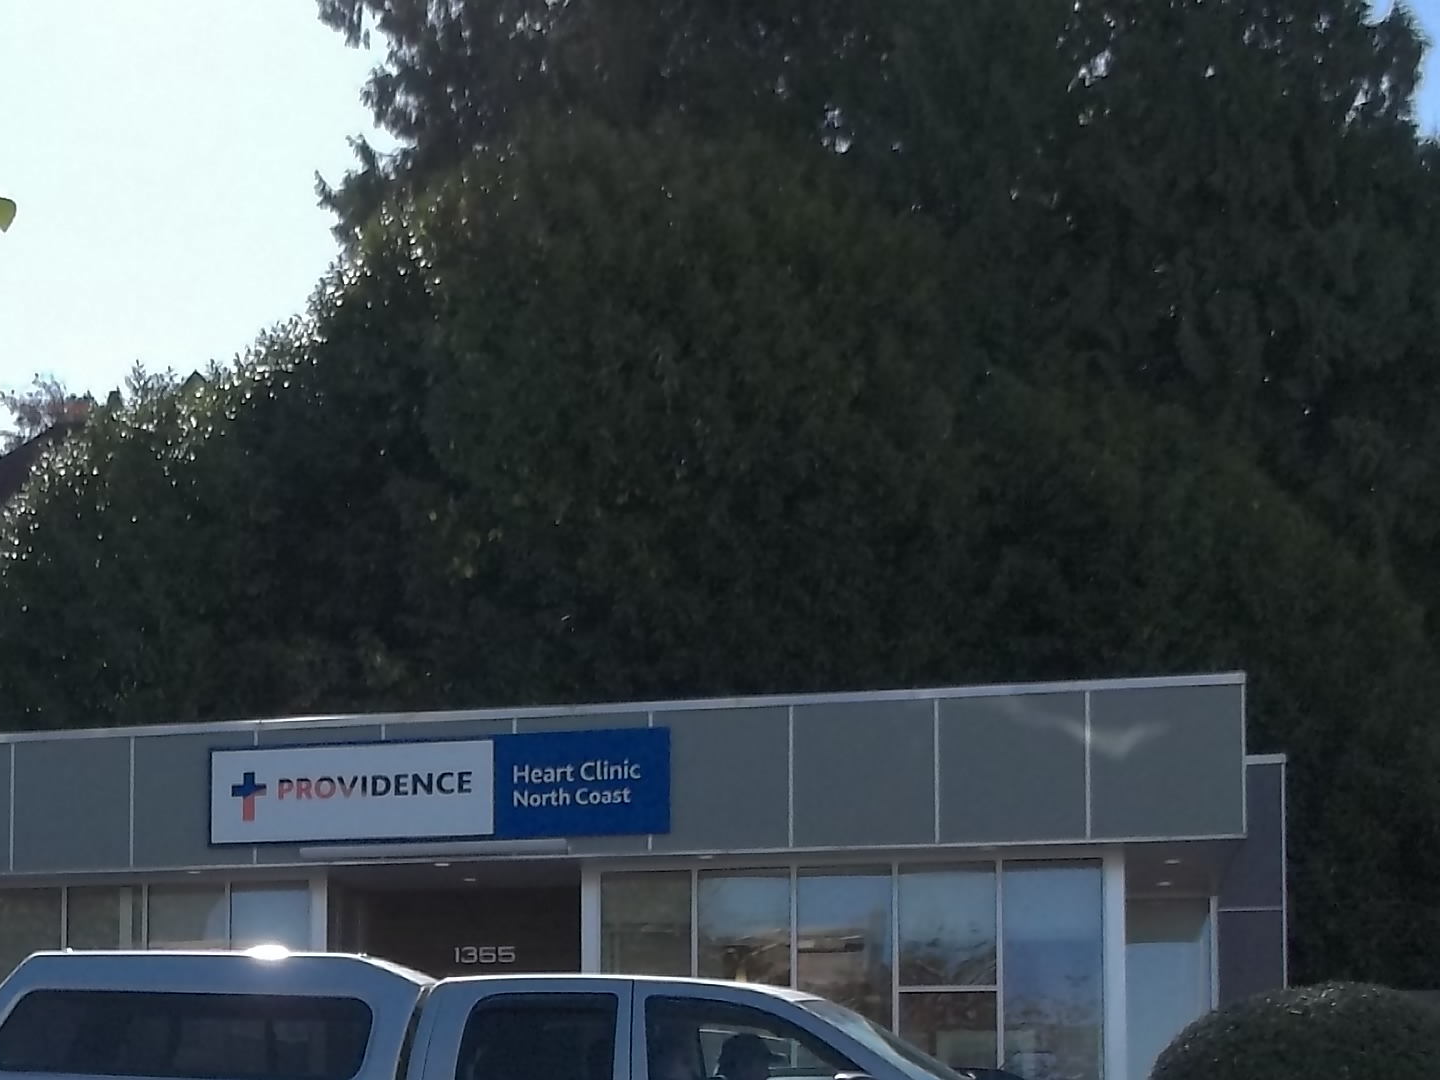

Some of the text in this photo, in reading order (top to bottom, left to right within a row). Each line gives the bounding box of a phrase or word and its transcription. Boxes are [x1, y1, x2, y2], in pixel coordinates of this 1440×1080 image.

[513, 758, 642, 785] Heart Clinic
[278, 771, 473, 800] PROVIDENCE
[513, 786, 632, 808] North Coast
[454, 946, 516, 963] 1355
